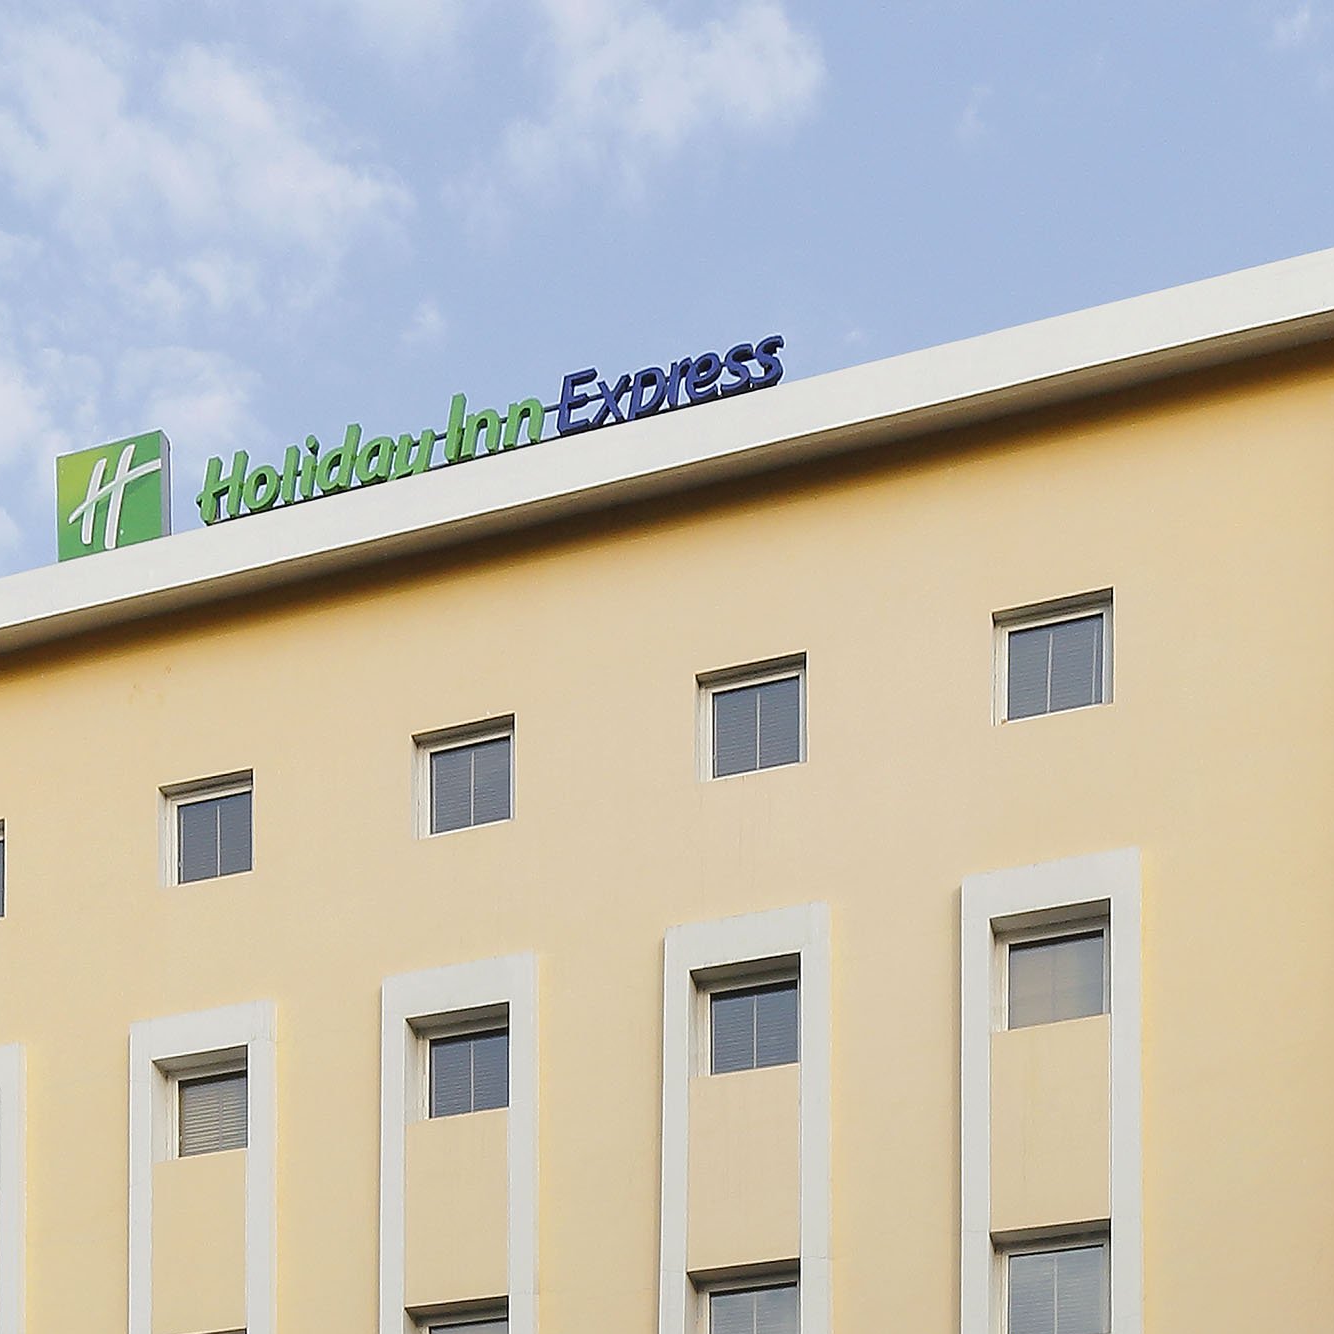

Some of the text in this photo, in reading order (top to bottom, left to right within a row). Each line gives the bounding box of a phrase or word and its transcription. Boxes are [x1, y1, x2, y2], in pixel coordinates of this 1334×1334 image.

[196, 335, 785, 525] Holiday Inn Express
